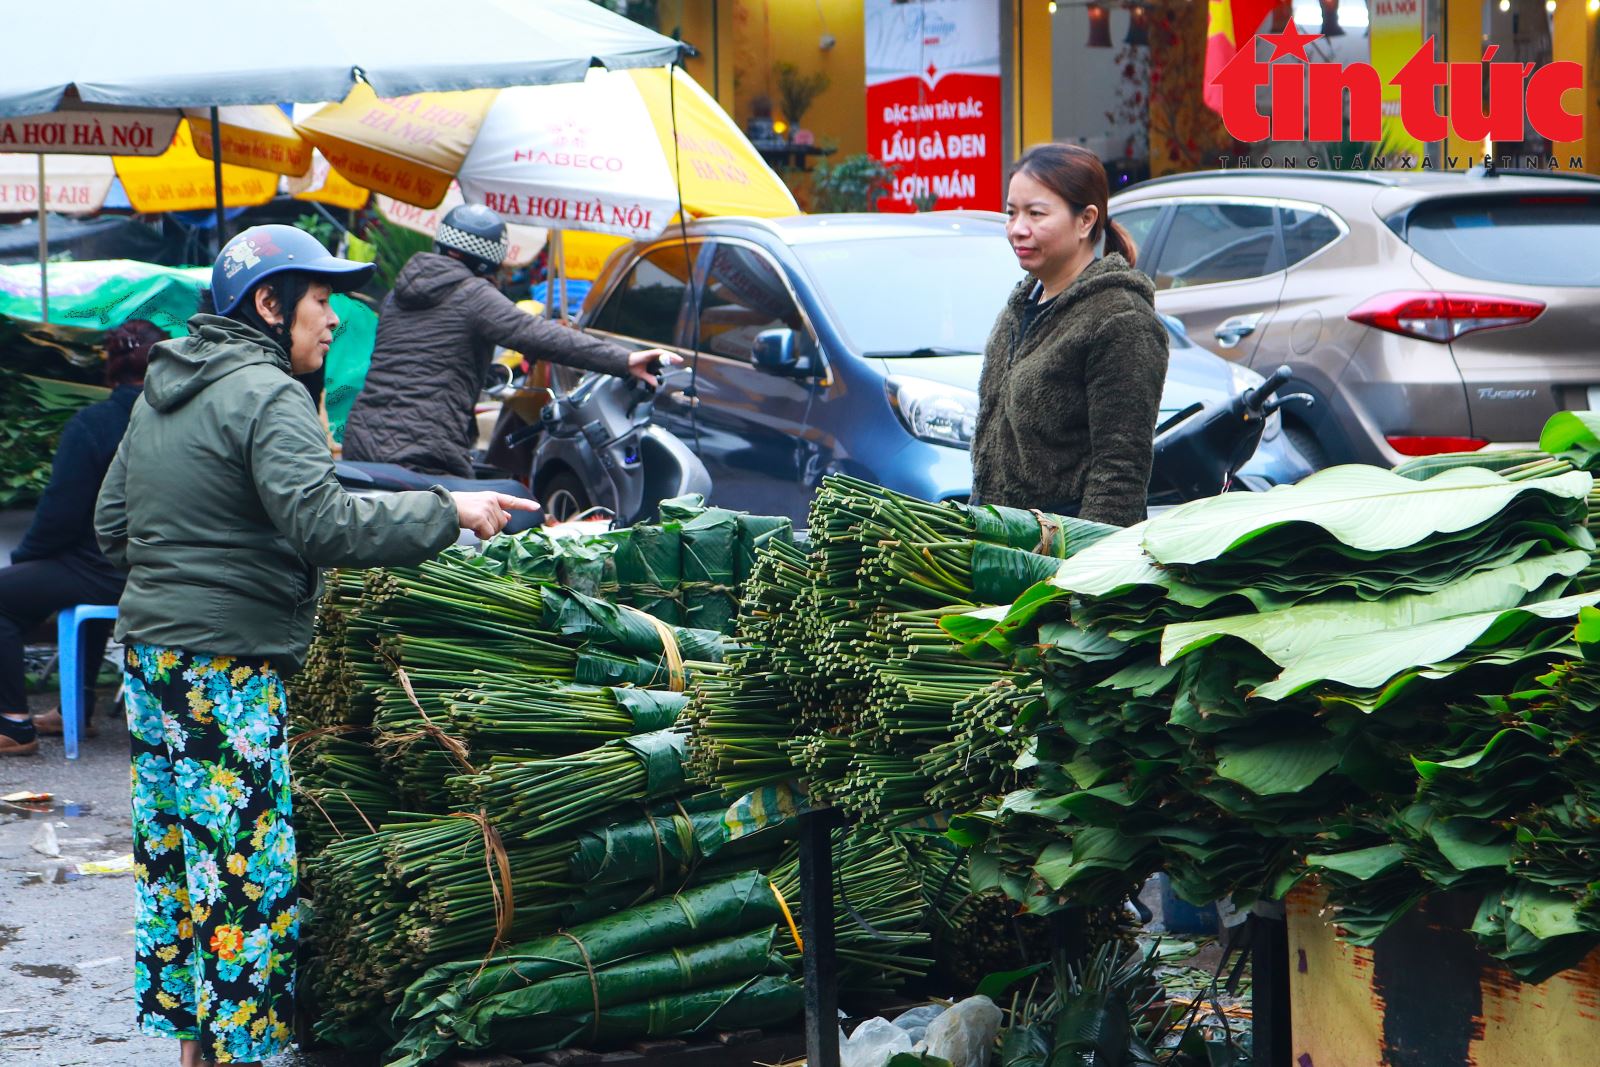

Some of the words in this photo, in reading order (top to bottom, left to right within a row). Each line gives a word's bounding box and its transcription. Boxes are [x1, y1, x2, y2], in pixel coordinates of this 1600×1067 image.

[23, 123, 65, 145] HƠI
[73, 117, 105, 147] HÀ
[112, 121, 154, 152] NỘI
[919, 130, 946, 160] GÀ
[947, 133, 986, 159] ĐEN
[514, 150, 623, 172] HABECO
[932, 169, 976, 198] MÁN
[485, 192, 521, 215] BIA
[526, 196, 568, 220] HƠI
[574, 198, 608, 223] HÀ
[611, 204, 652, 234] NỘI
